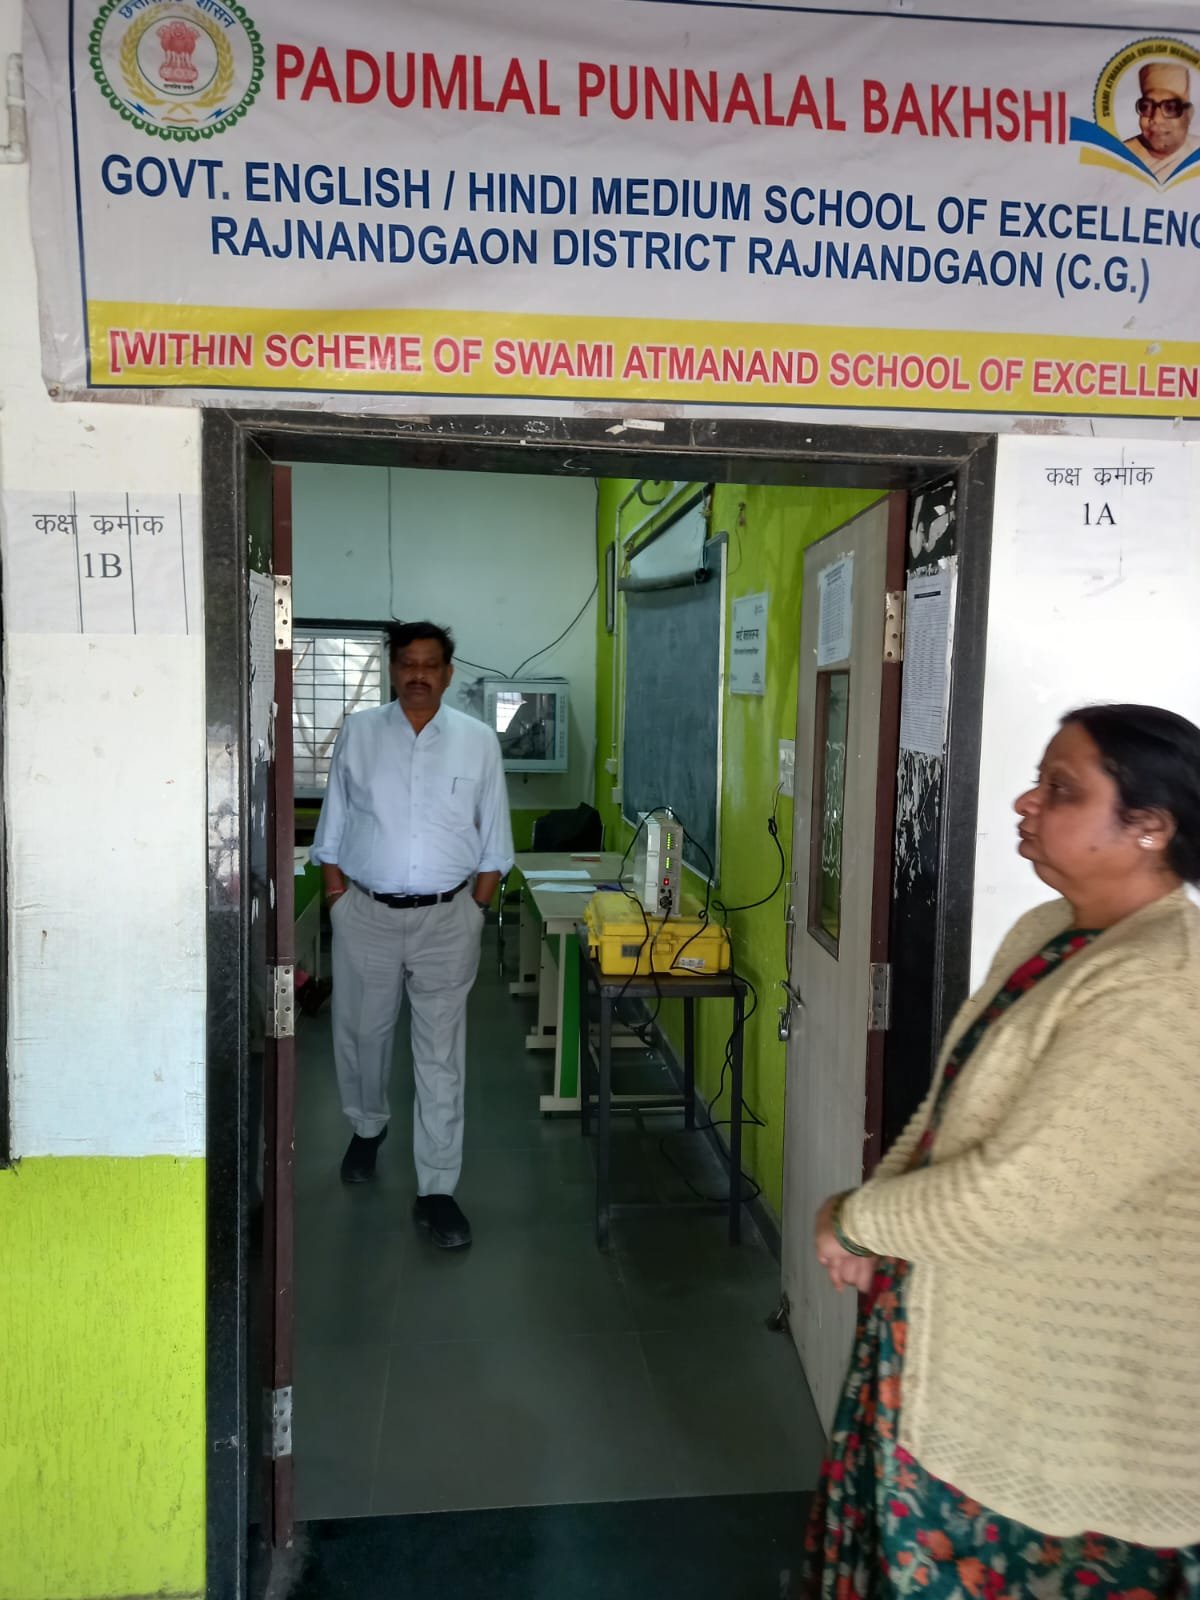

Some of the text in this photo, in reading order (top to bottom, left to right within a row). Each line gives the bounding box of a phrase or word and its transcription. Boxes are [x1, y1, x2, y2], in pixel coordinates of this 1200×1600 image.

[276, 43, 1067, 145] PADUMLAL PUNNALAL BAKHSHI
[101, 154, 229, 199] GOVT.
[245, 161, 431, 210] ENGLISH
[443, 169, 456, 211] /
[468, 171, 577, 215] HINDI
[591, 176, 752, 222] MEDIUM
[764, 185, 926, 234] SCHOOL
[937, 196, 987, 235] OF
[210, 215, 1150, 304] RAJNANDGAON DISTRICT RAJNANDGAON (C.G.)
[265, 333, 421, 372] SCHEME
[433, 337, 482, 374] OF
[494, 340, 614, 379] SWAMI
[623, 346, 819, 385] ATMANAND
[829, 352, 970, 391] SCHOOL
[979, 358, 1024, 393] OF
[1033, 361, 1199, 398] EXCELLEN
[1045, 467, 1082, 486] कक्ष
[32, 514, 77, 535] कक्ष
[1083, 502, 1117, 526] 1A
[83, 553, 122, 578] 1B
